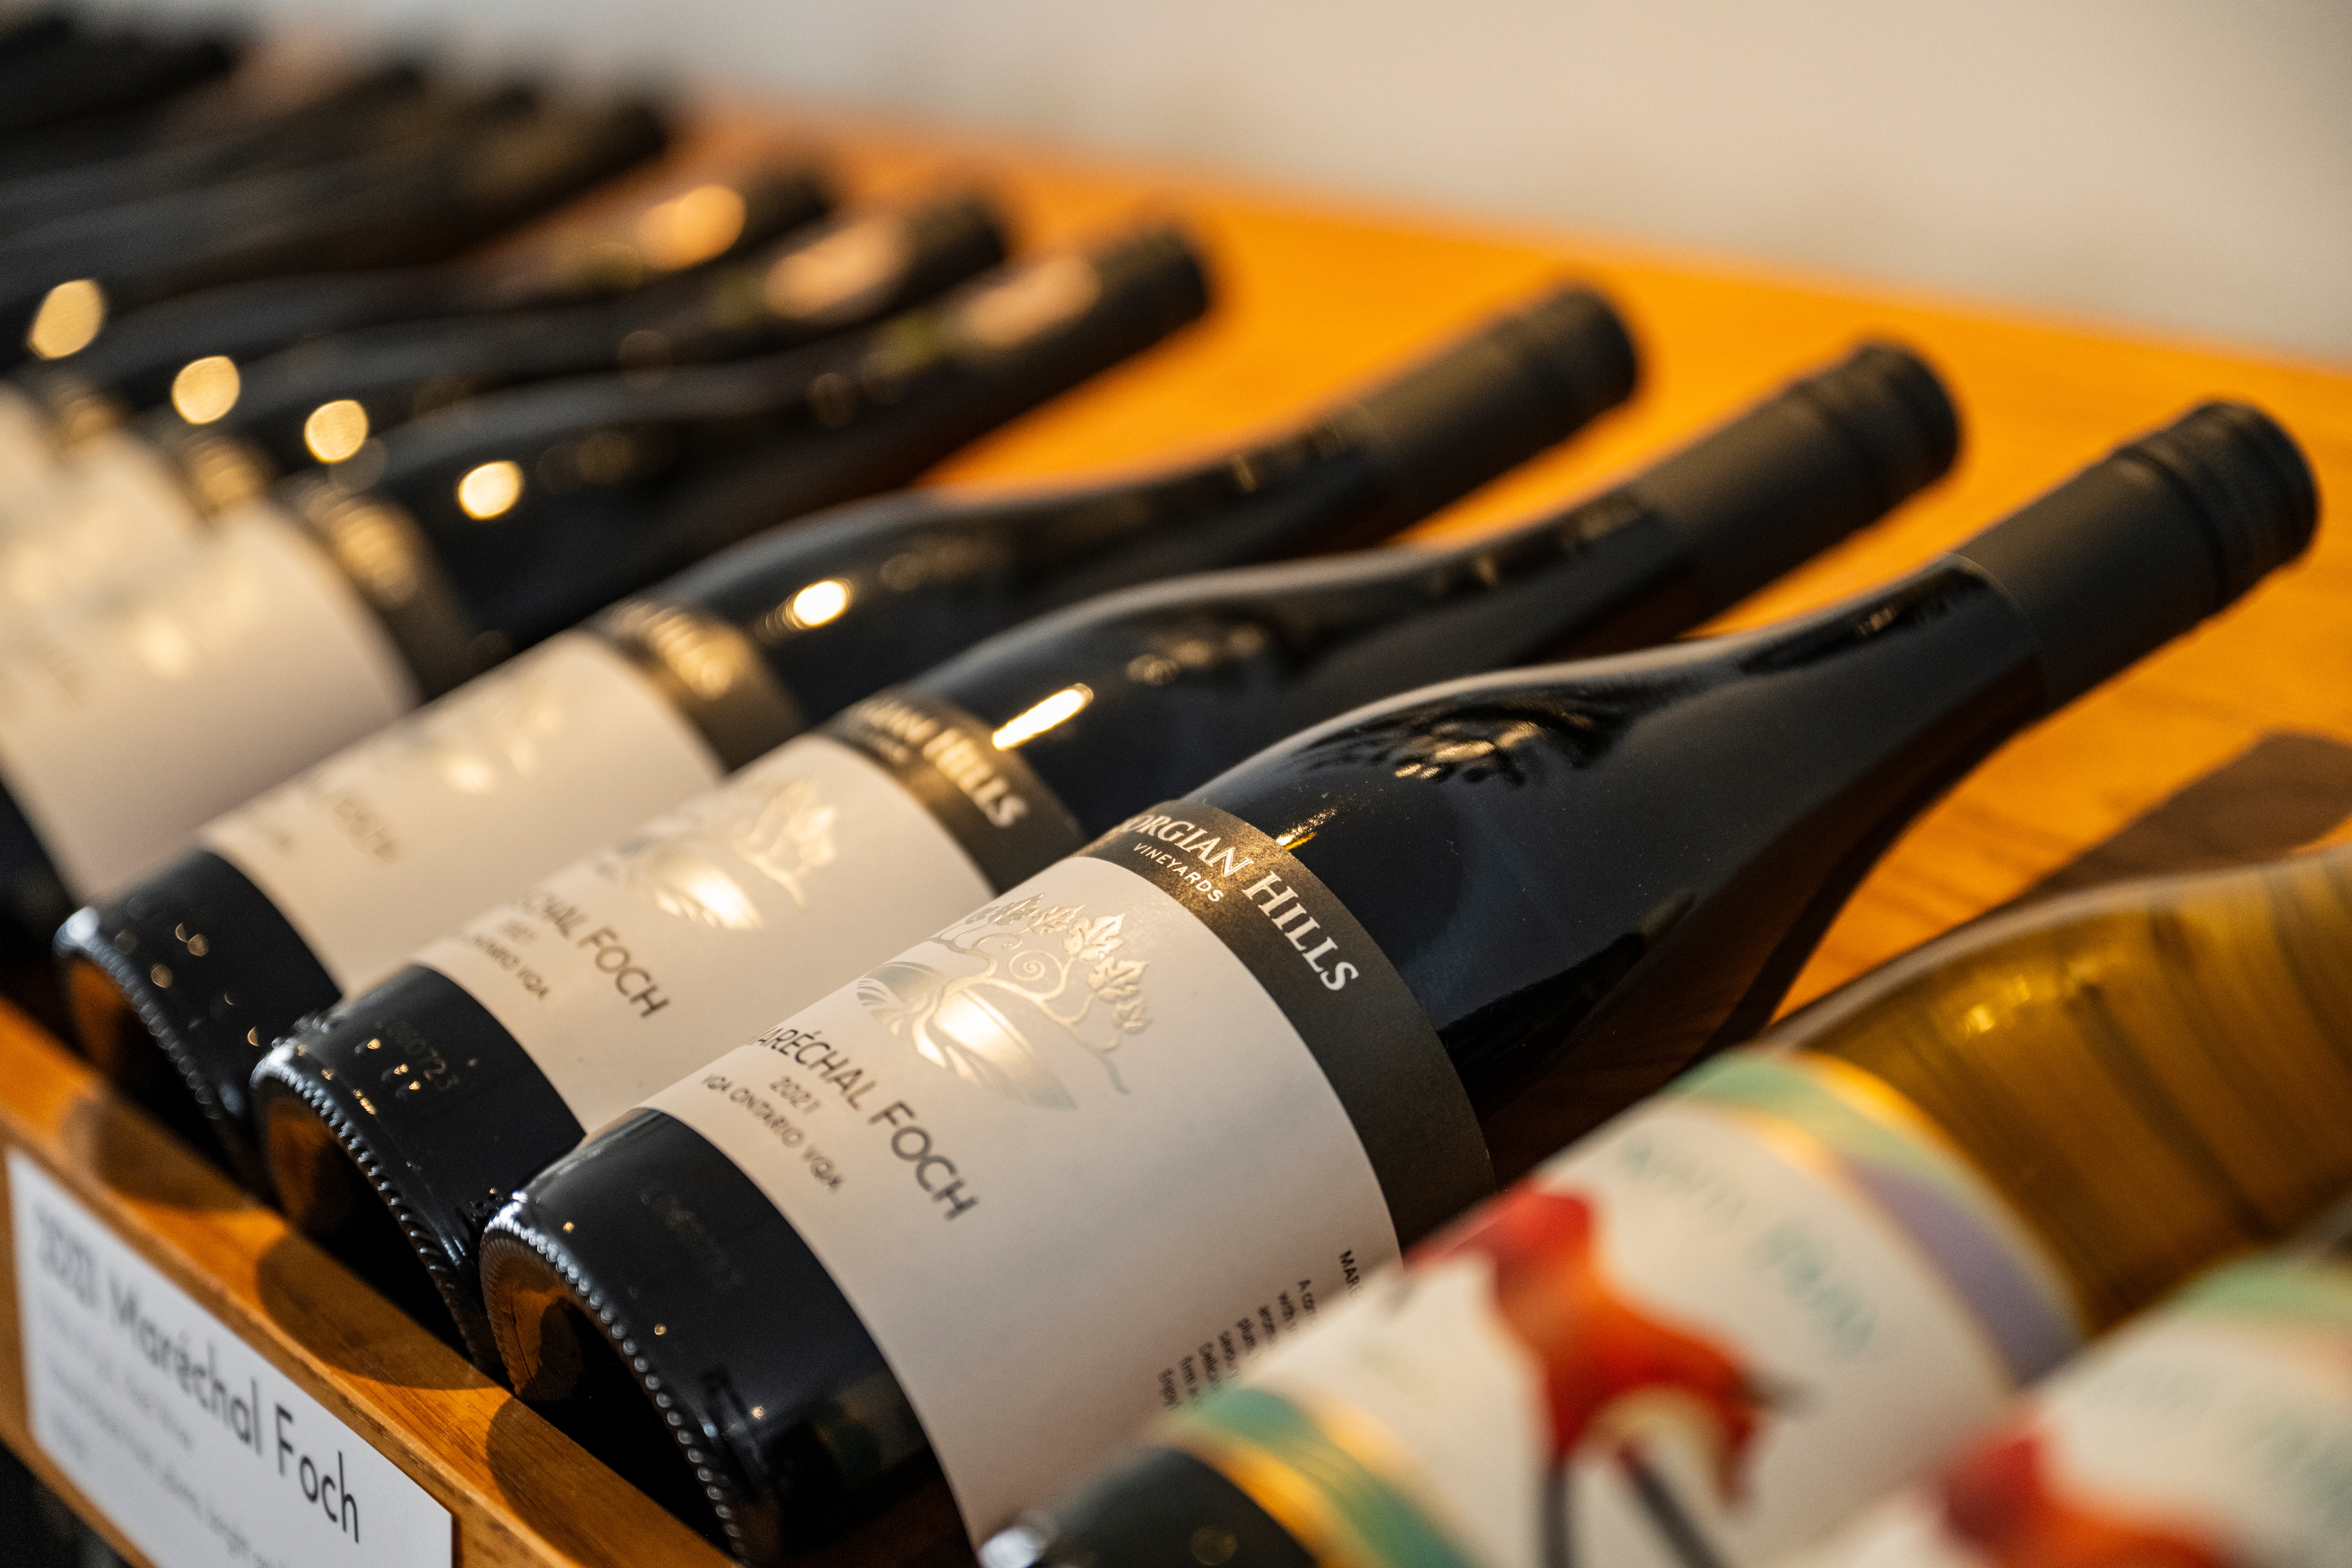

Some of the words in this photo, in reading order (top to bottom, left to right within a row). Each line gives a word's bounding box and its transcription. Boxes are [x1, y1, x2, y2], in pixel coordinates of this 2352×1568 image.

[1123, 815, 1254, 878] ORGIAN
[1242, 871, 1359, 991] HILLS
[1134, 842, 1224, 902] VINEYARDS
[575, 925, 670, 1019] FOCH
[729, 1087, 805, 1149] ONTARIO
[801, 1144, 845, 1194] VQA
[769, 1076, 822, 1116] 2021
[867, 1099, 979, 1221] FOCH
[107, 1270, 264, 1458] Maréchal
[275, 1401, 360, 1545] Foch
